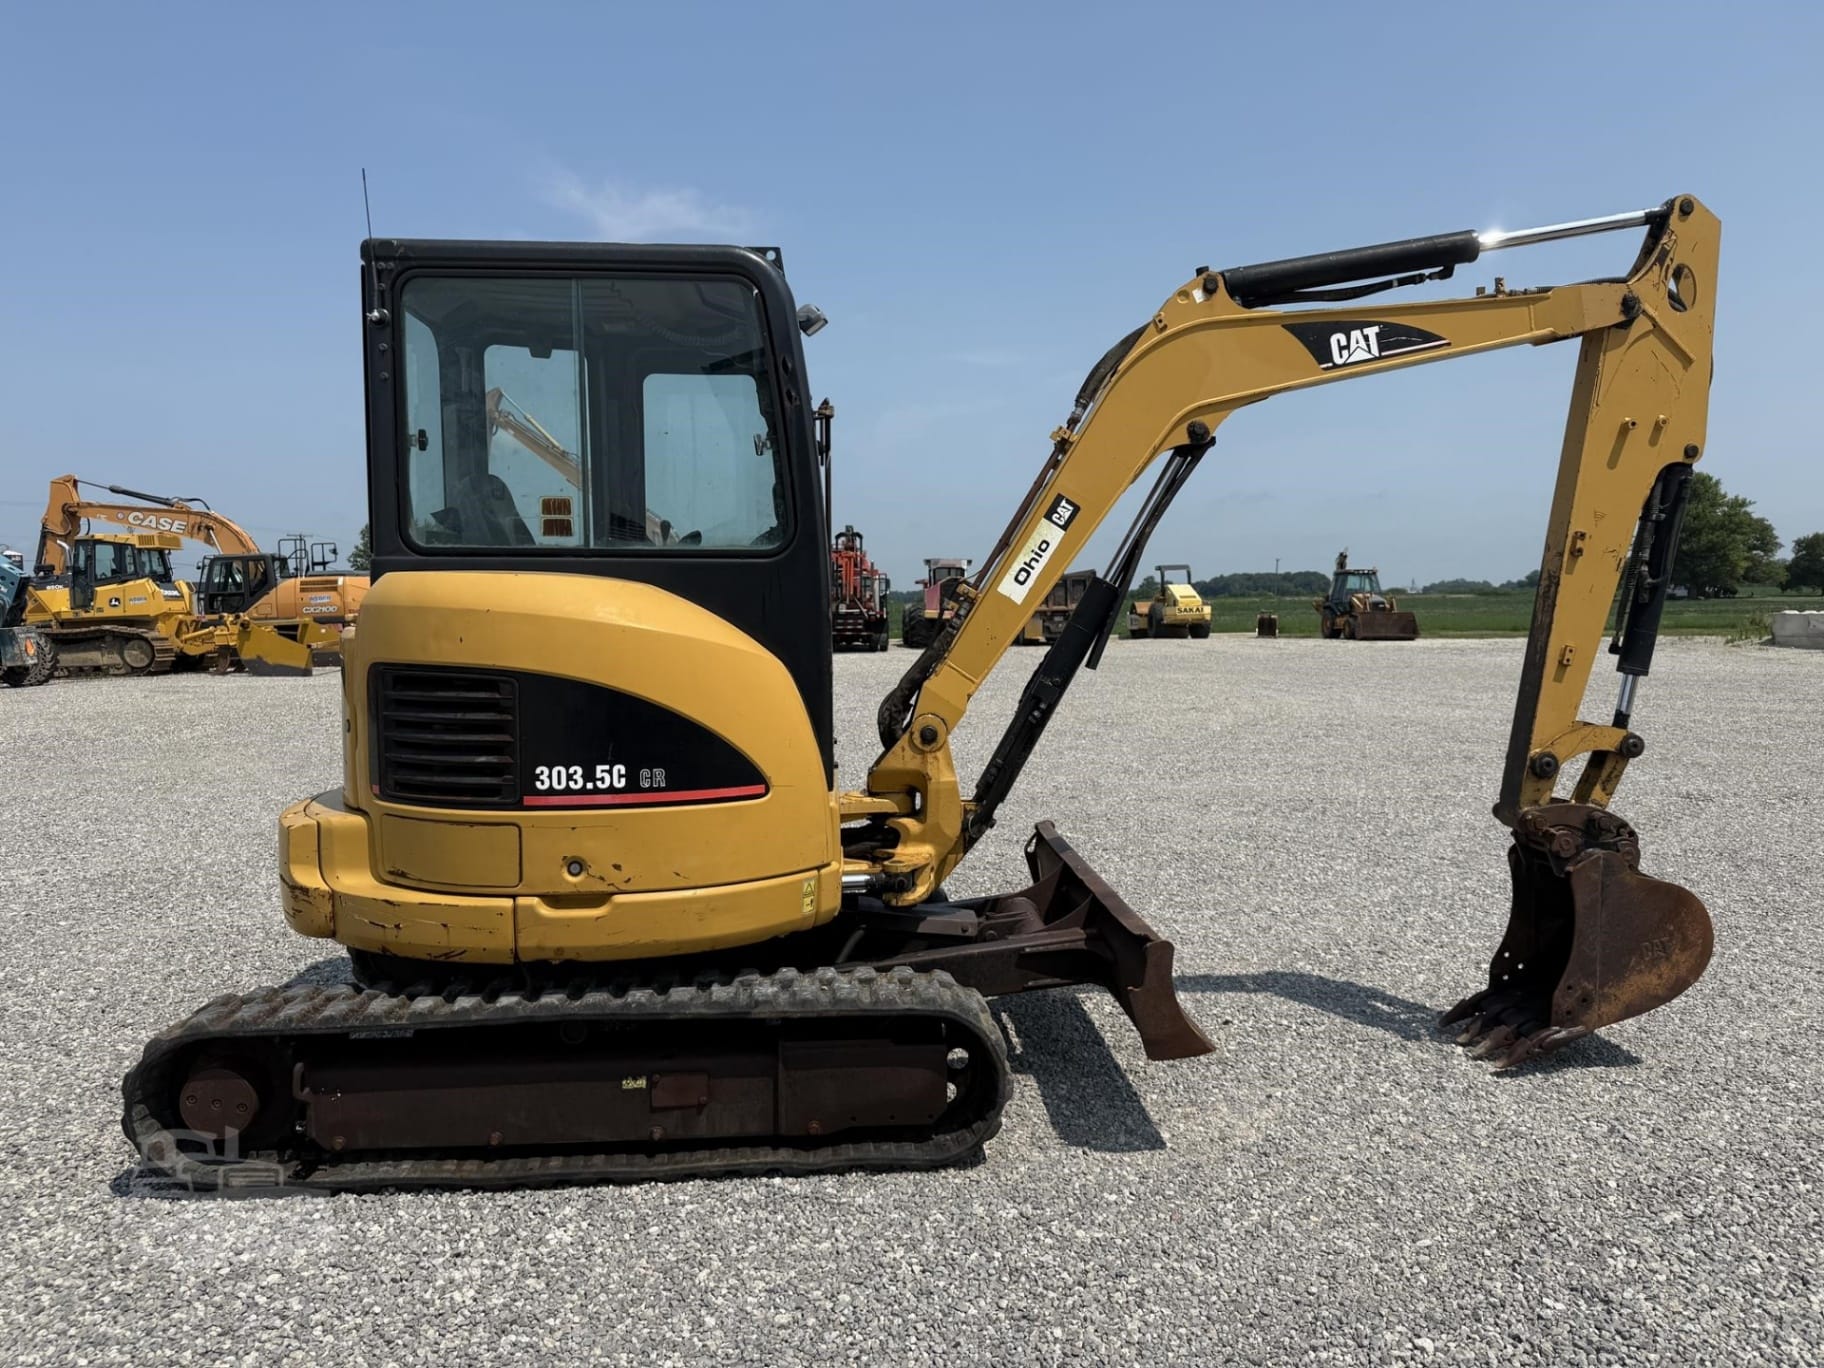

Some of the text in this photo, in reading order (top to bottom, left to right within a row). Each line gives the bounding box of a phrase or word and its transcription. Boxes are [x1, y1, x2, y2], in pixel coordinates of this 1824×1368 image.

[1330, 326, 1380, 365] CAT
[127, 511, 188, 534] CASE
[1051, 497, 1074, 526] CAT
[1014, 538, 1051, 586] Ohio
[535, 764, 666, 790] 303.5C CR
